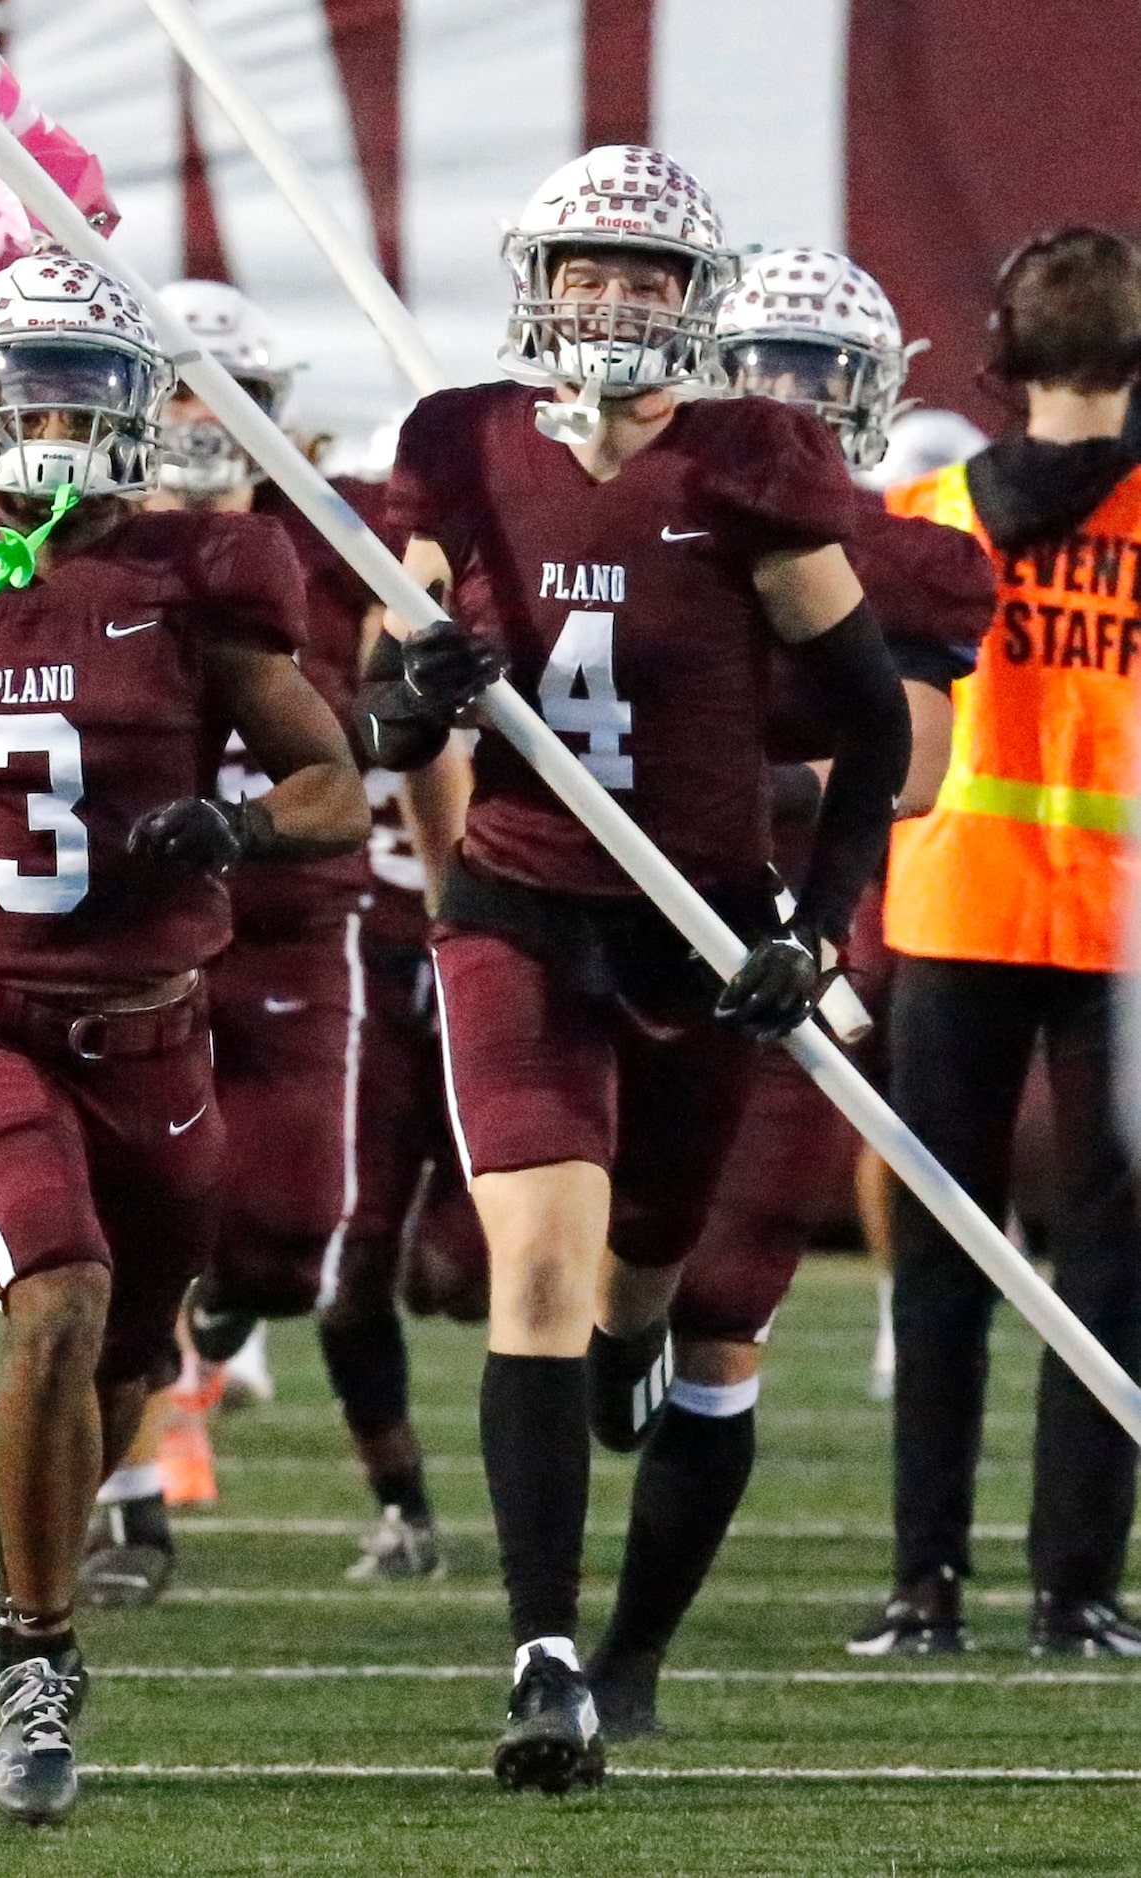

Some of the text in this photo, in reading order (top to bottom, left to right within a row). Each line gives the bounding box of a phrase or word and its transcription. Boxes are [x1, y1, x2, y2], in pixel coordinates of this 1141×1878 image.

[539, 562, 626, 603] PLANO
[1005, 601, 1141, 676] STAFF
[538, 609, 633, 790] 4
